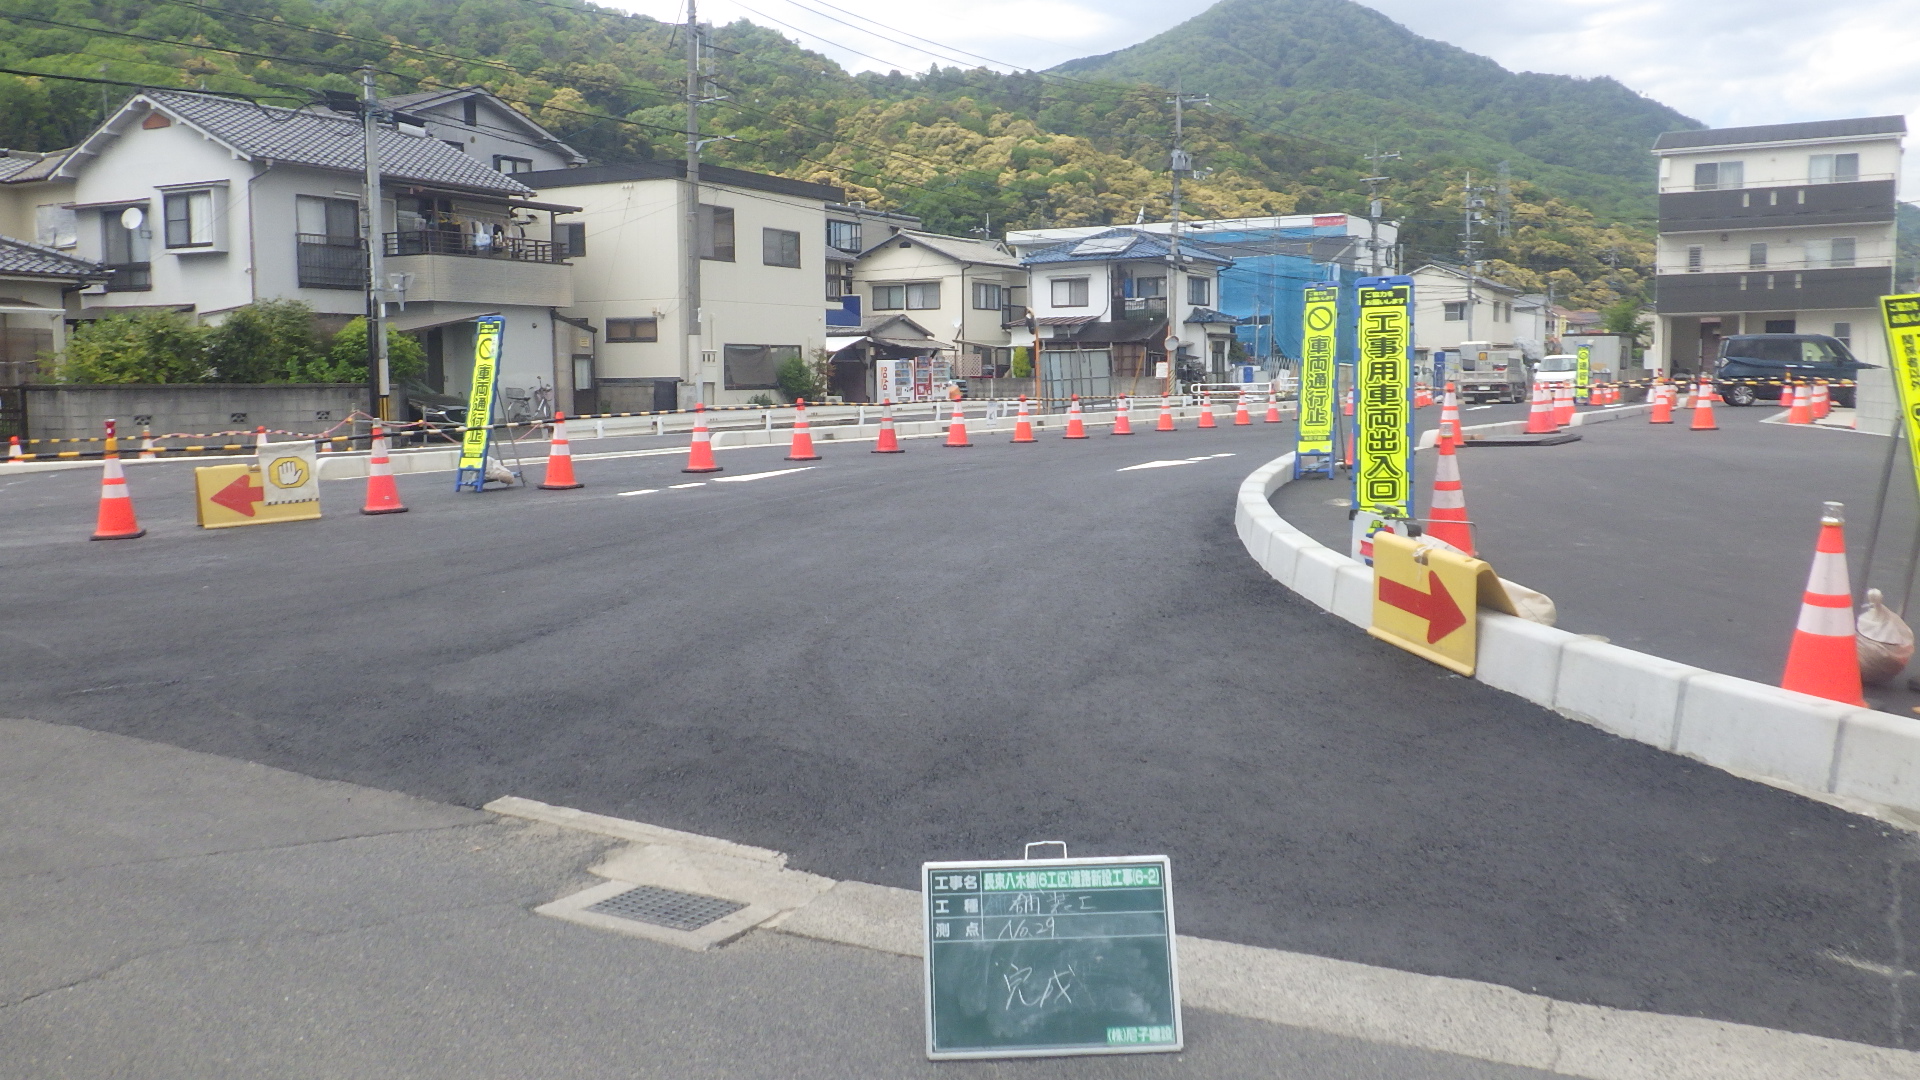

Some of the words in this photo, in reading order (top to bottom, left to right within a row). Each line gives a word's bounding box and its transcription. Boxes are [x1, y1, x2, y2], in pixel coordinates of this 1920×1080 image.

[467, 364, 493, 445] 車両通行止
[1304, 335, 1331, 426] 車両通行止
[1364, 311, 1403, 502] 工事用車両出入口
[934, 874, 977, 891] 工事名
[935, 922, 980, 938] 測点
